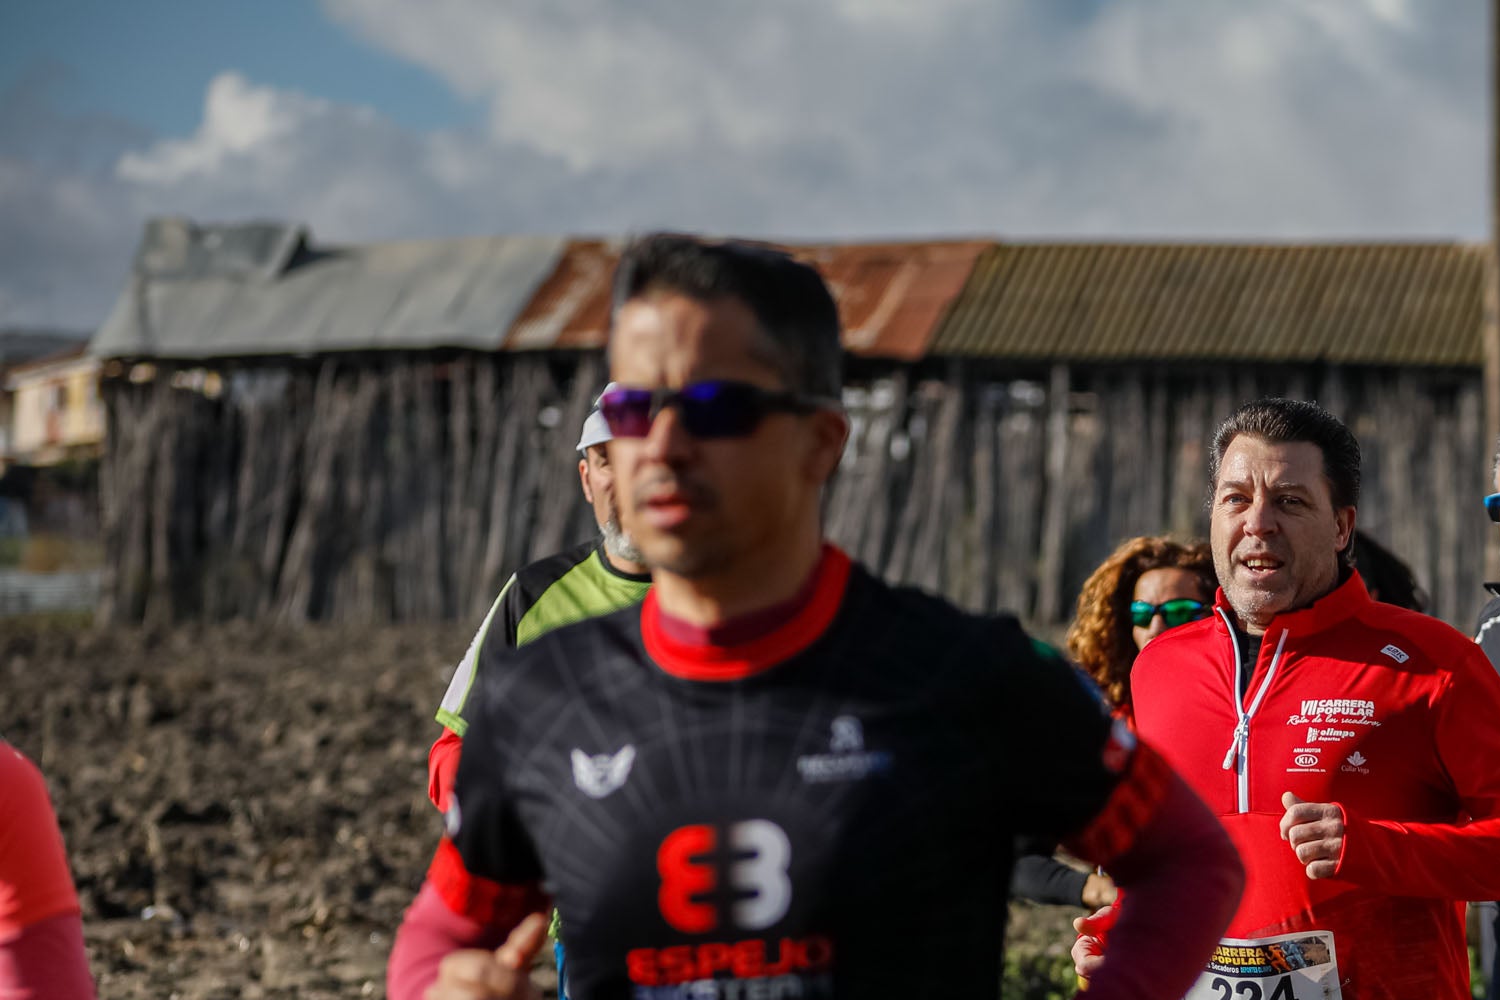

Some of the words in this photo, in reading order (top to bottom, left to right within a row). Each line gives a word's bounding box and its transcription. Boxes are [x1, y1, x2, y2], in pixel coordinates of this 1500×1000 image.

[1301, 699, 1318, 716] VII
[1319, 699, 1375, 709] CARRERA
[1316, 707, 1374, 717] POPULAR
[1287, 715, 1309, 725] Ruta
[1312, 714, 1322, 723] de
[1325, 714, 1338, 723] los
[1320, 728, 1355, 738] olimpo
[1213, 946, 1265, 957] ARRERA
[626, 931, 835, 985] ESPEJO
[1211, 954, 1266, 966] POPULAR
[1211, 962, 1240, 973] Secaderos
